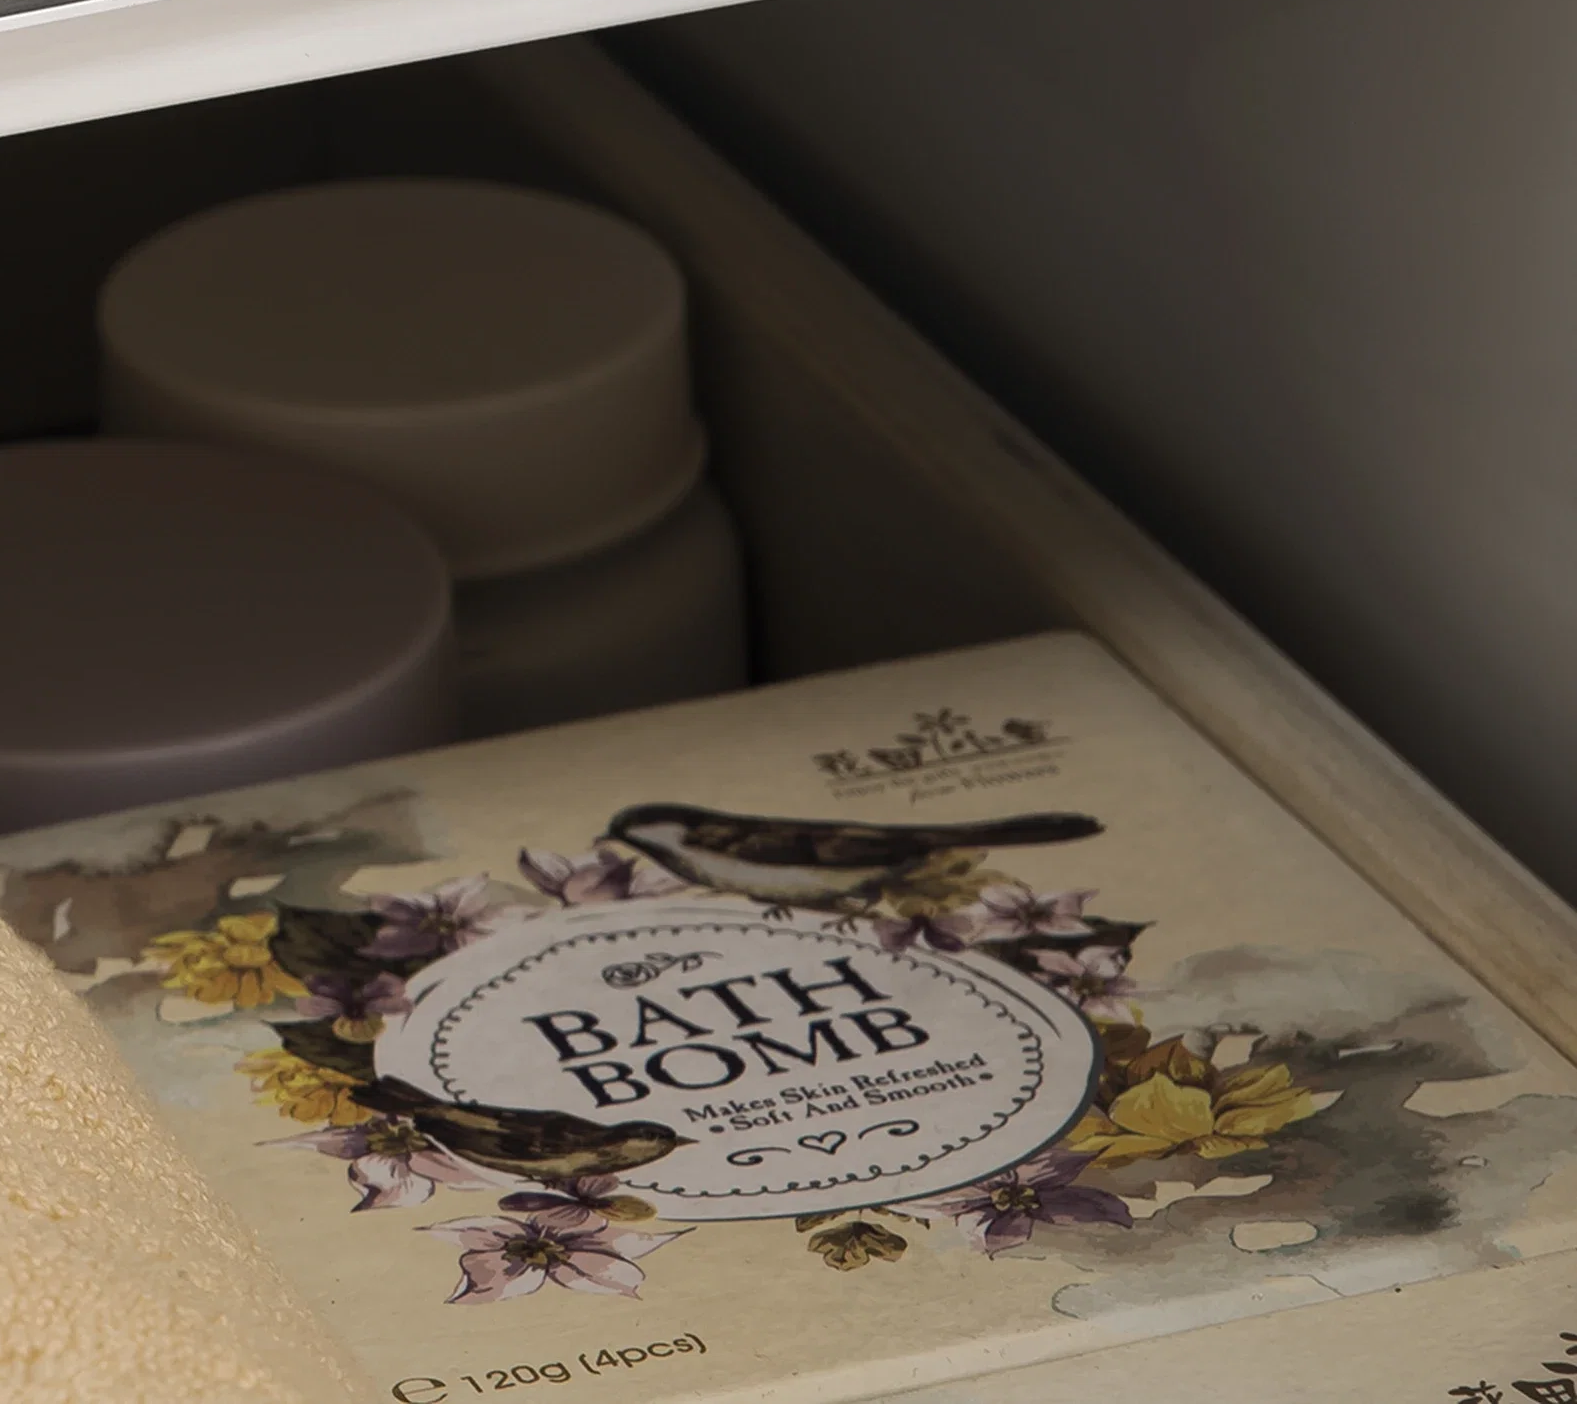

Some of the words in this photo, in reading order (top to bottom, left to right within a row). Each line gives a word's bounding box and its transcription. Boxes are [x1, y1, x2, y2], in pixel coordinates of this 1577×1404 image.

[521, 956, 893, 1063] BATH
[562, 1006, 931, 1109] BOMB
[681, 1098, 776, 1124] Makes
[779, 1081, 848, 1105] Skin
[849, 1052, 988, 1091] Refreshed
[729, 1108, 794, 1132] Soft
[805, 1094, 861, 1119] And
[866, 1072, 977, 1106] Smooth
[460, 1361, 572, 1395] 120g
[578, 1332, 707, 1376] (4pcs)
